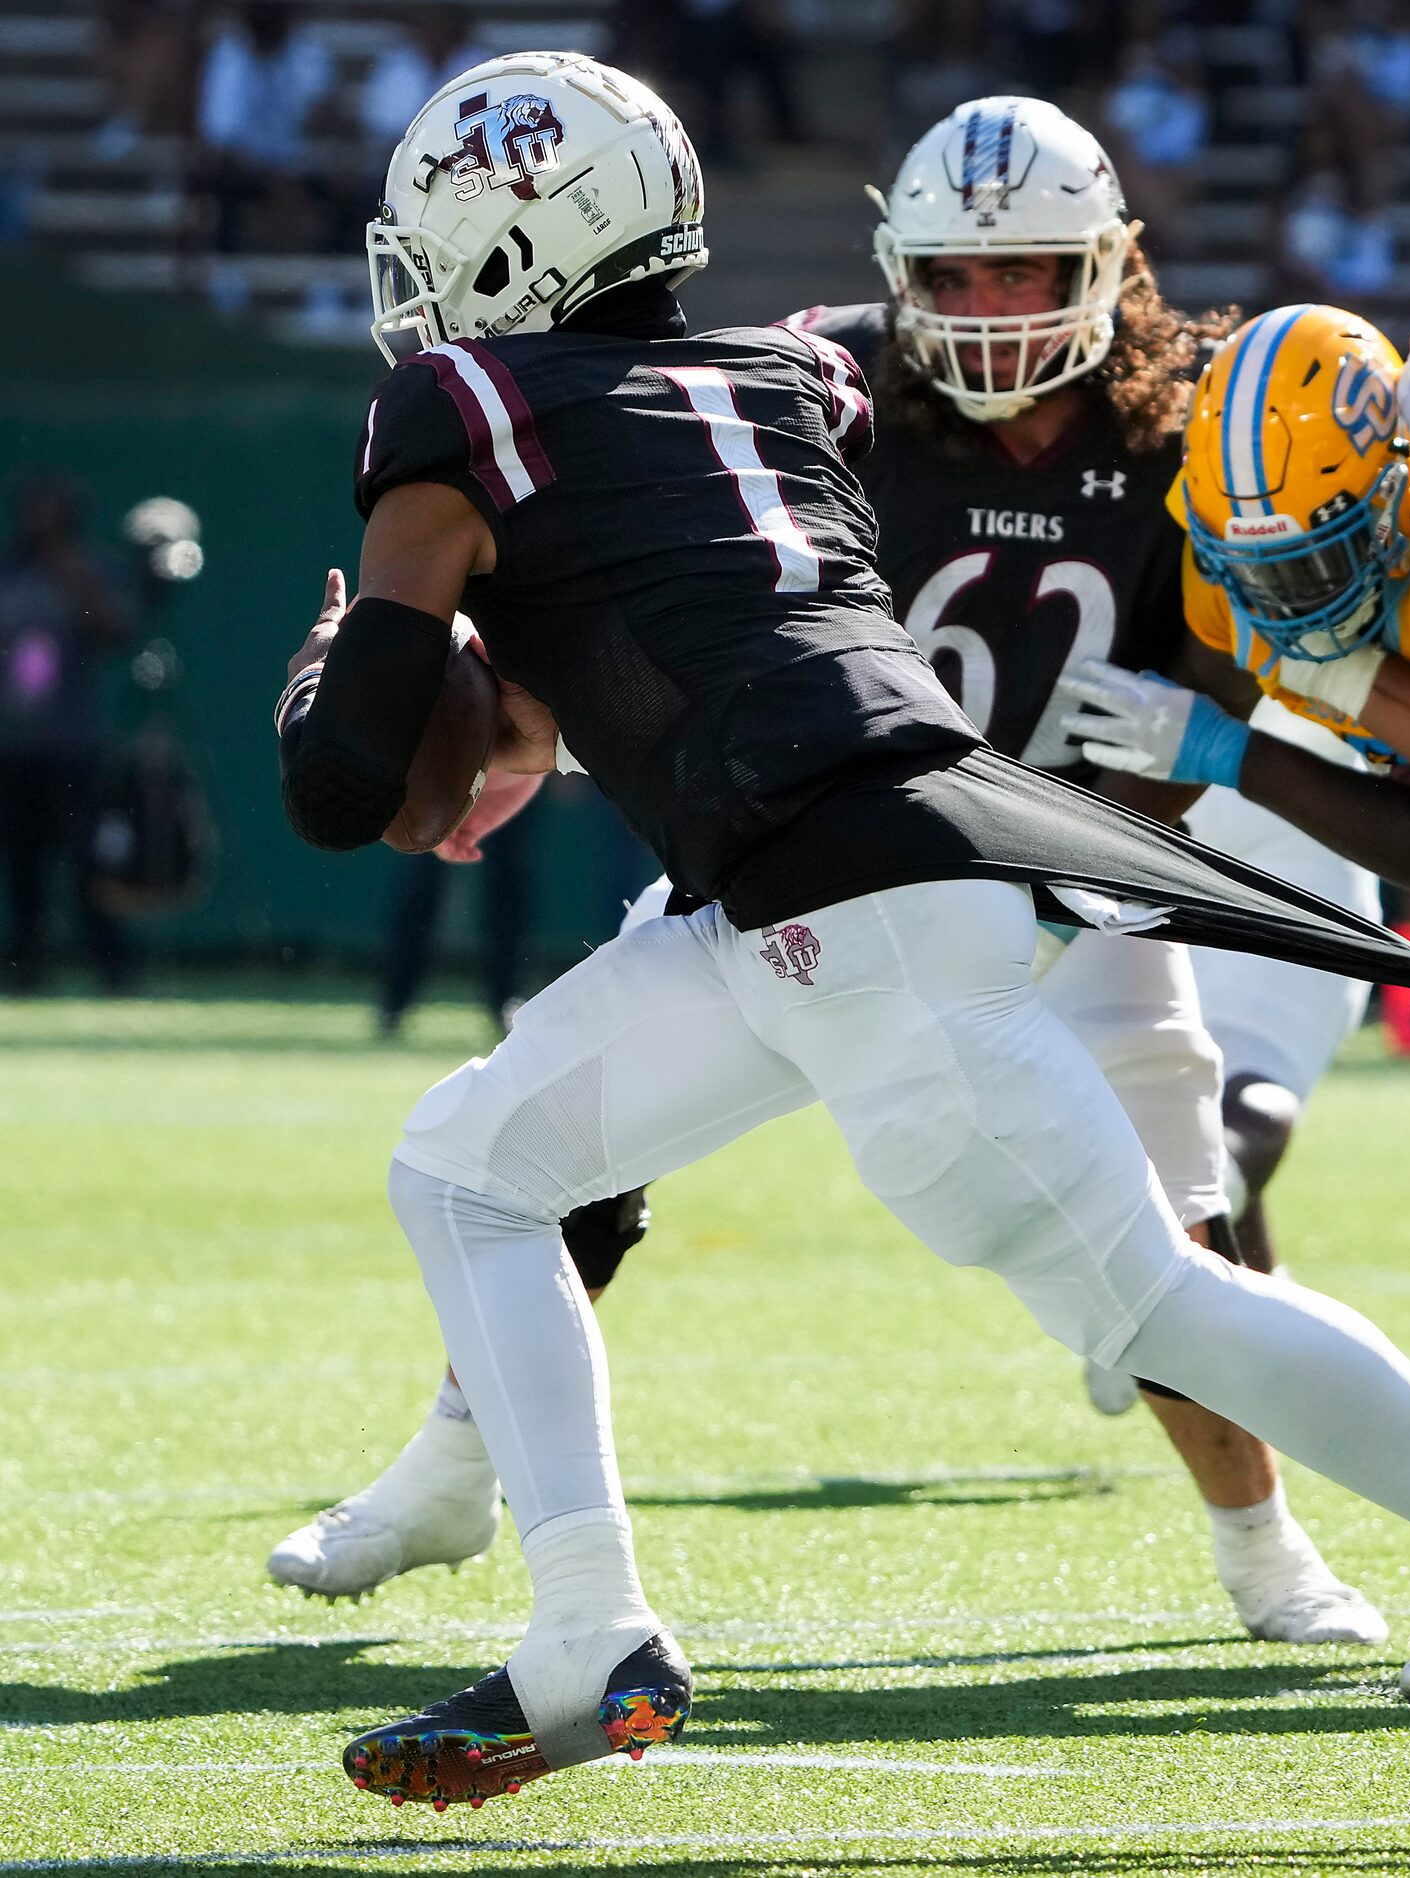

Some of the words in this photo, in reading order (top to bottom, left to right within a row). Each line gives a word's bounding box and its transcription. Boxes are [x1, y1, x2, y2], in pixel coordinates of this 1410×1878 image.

[651, 365, 823, 593] 1
[966, 507, 1065, 541] TIGERS
[1231, 521, 1288, 537] Riddell
[480, 1742, 537, 1765] RMOUR
